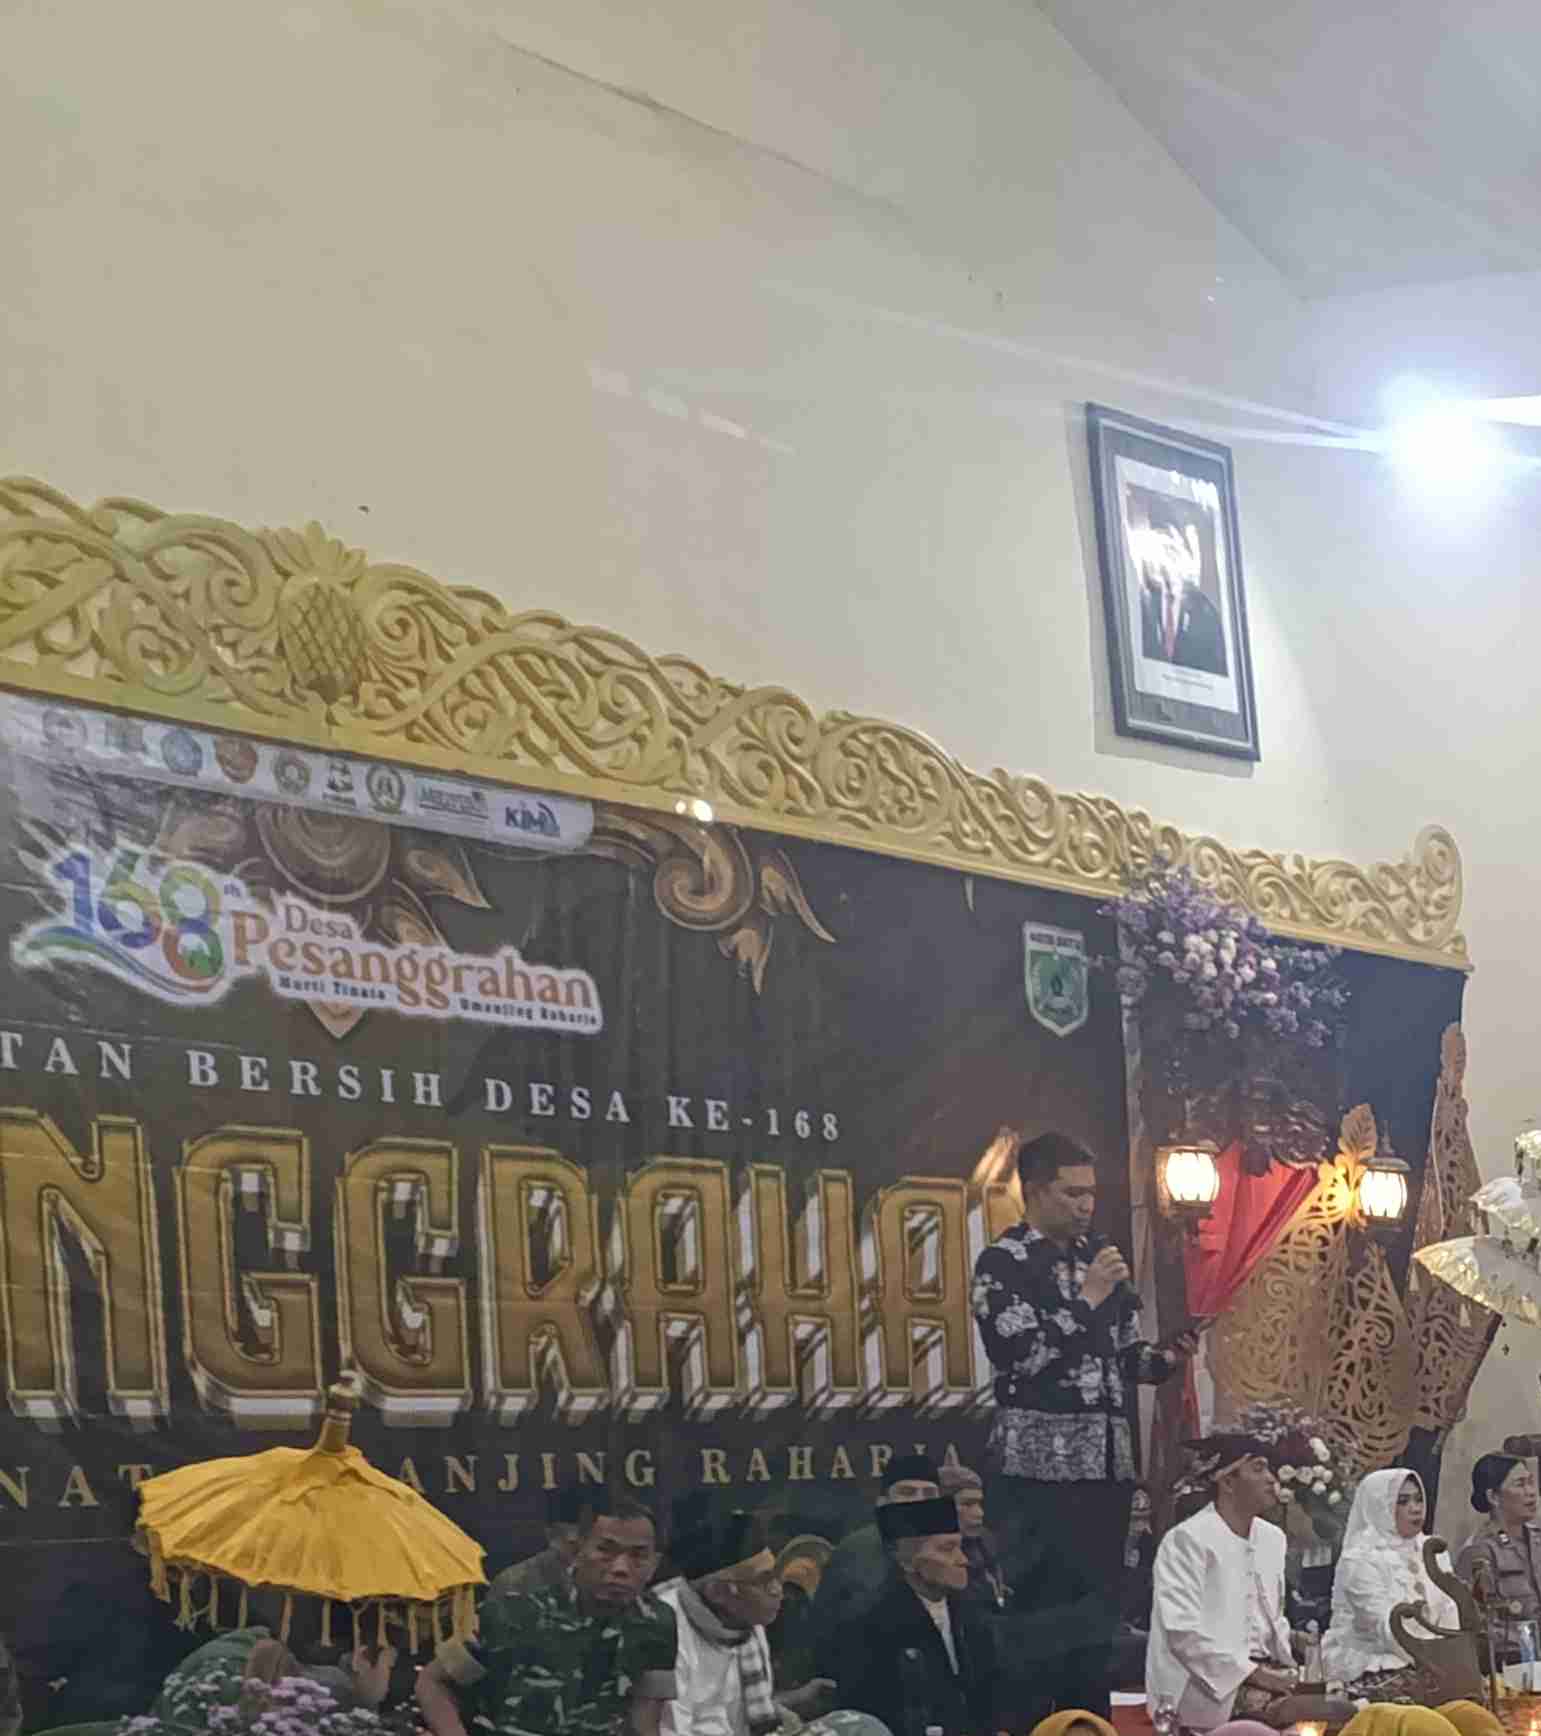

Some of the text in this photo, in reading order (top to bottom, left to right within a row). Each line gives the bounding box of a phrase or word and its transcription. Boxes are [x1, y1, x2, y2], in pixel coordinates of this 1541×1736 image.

[231, 910, 593, 1010] Pesanggrahan
[284, 903, 354, 941] Desa
[186, 1049, 442, 1107] BERSIH
[484, 1078, 631, 1124] DESA
[666, 1094, 840, 1142] KE-168
[0, 1106, 1012, 1422] NGGRAHA
[402, 1447, 657, 1496] ANJING
[701, 1442, 961, 1486] RAHARA
